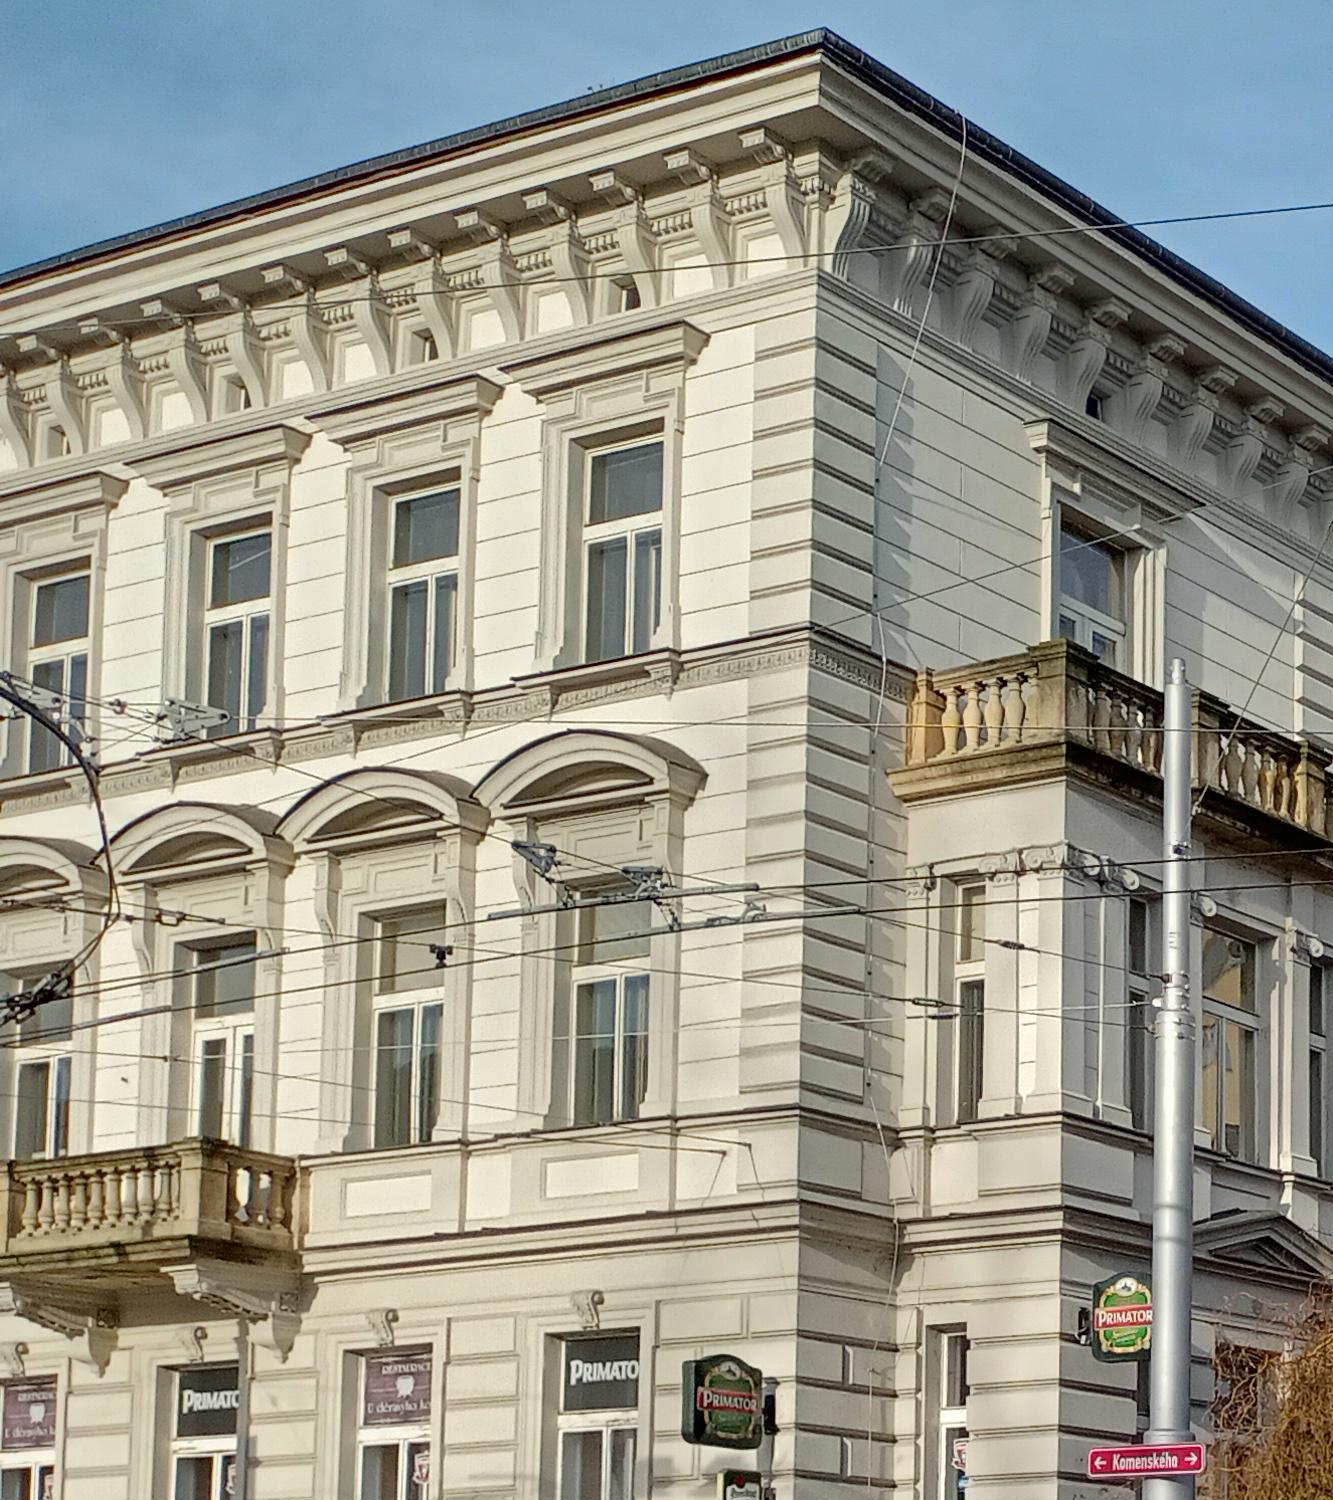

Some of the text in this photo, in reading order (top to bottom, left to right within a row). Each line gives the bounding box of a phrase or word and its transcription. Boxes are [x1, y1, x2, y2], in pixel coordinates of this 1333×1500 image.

[1098, 1309, 1153, 1328] PRIMATOR
[703, 1389, 757, 1410] PRIMATOR
[1112, 1451, 1178, 1471] Komenského
